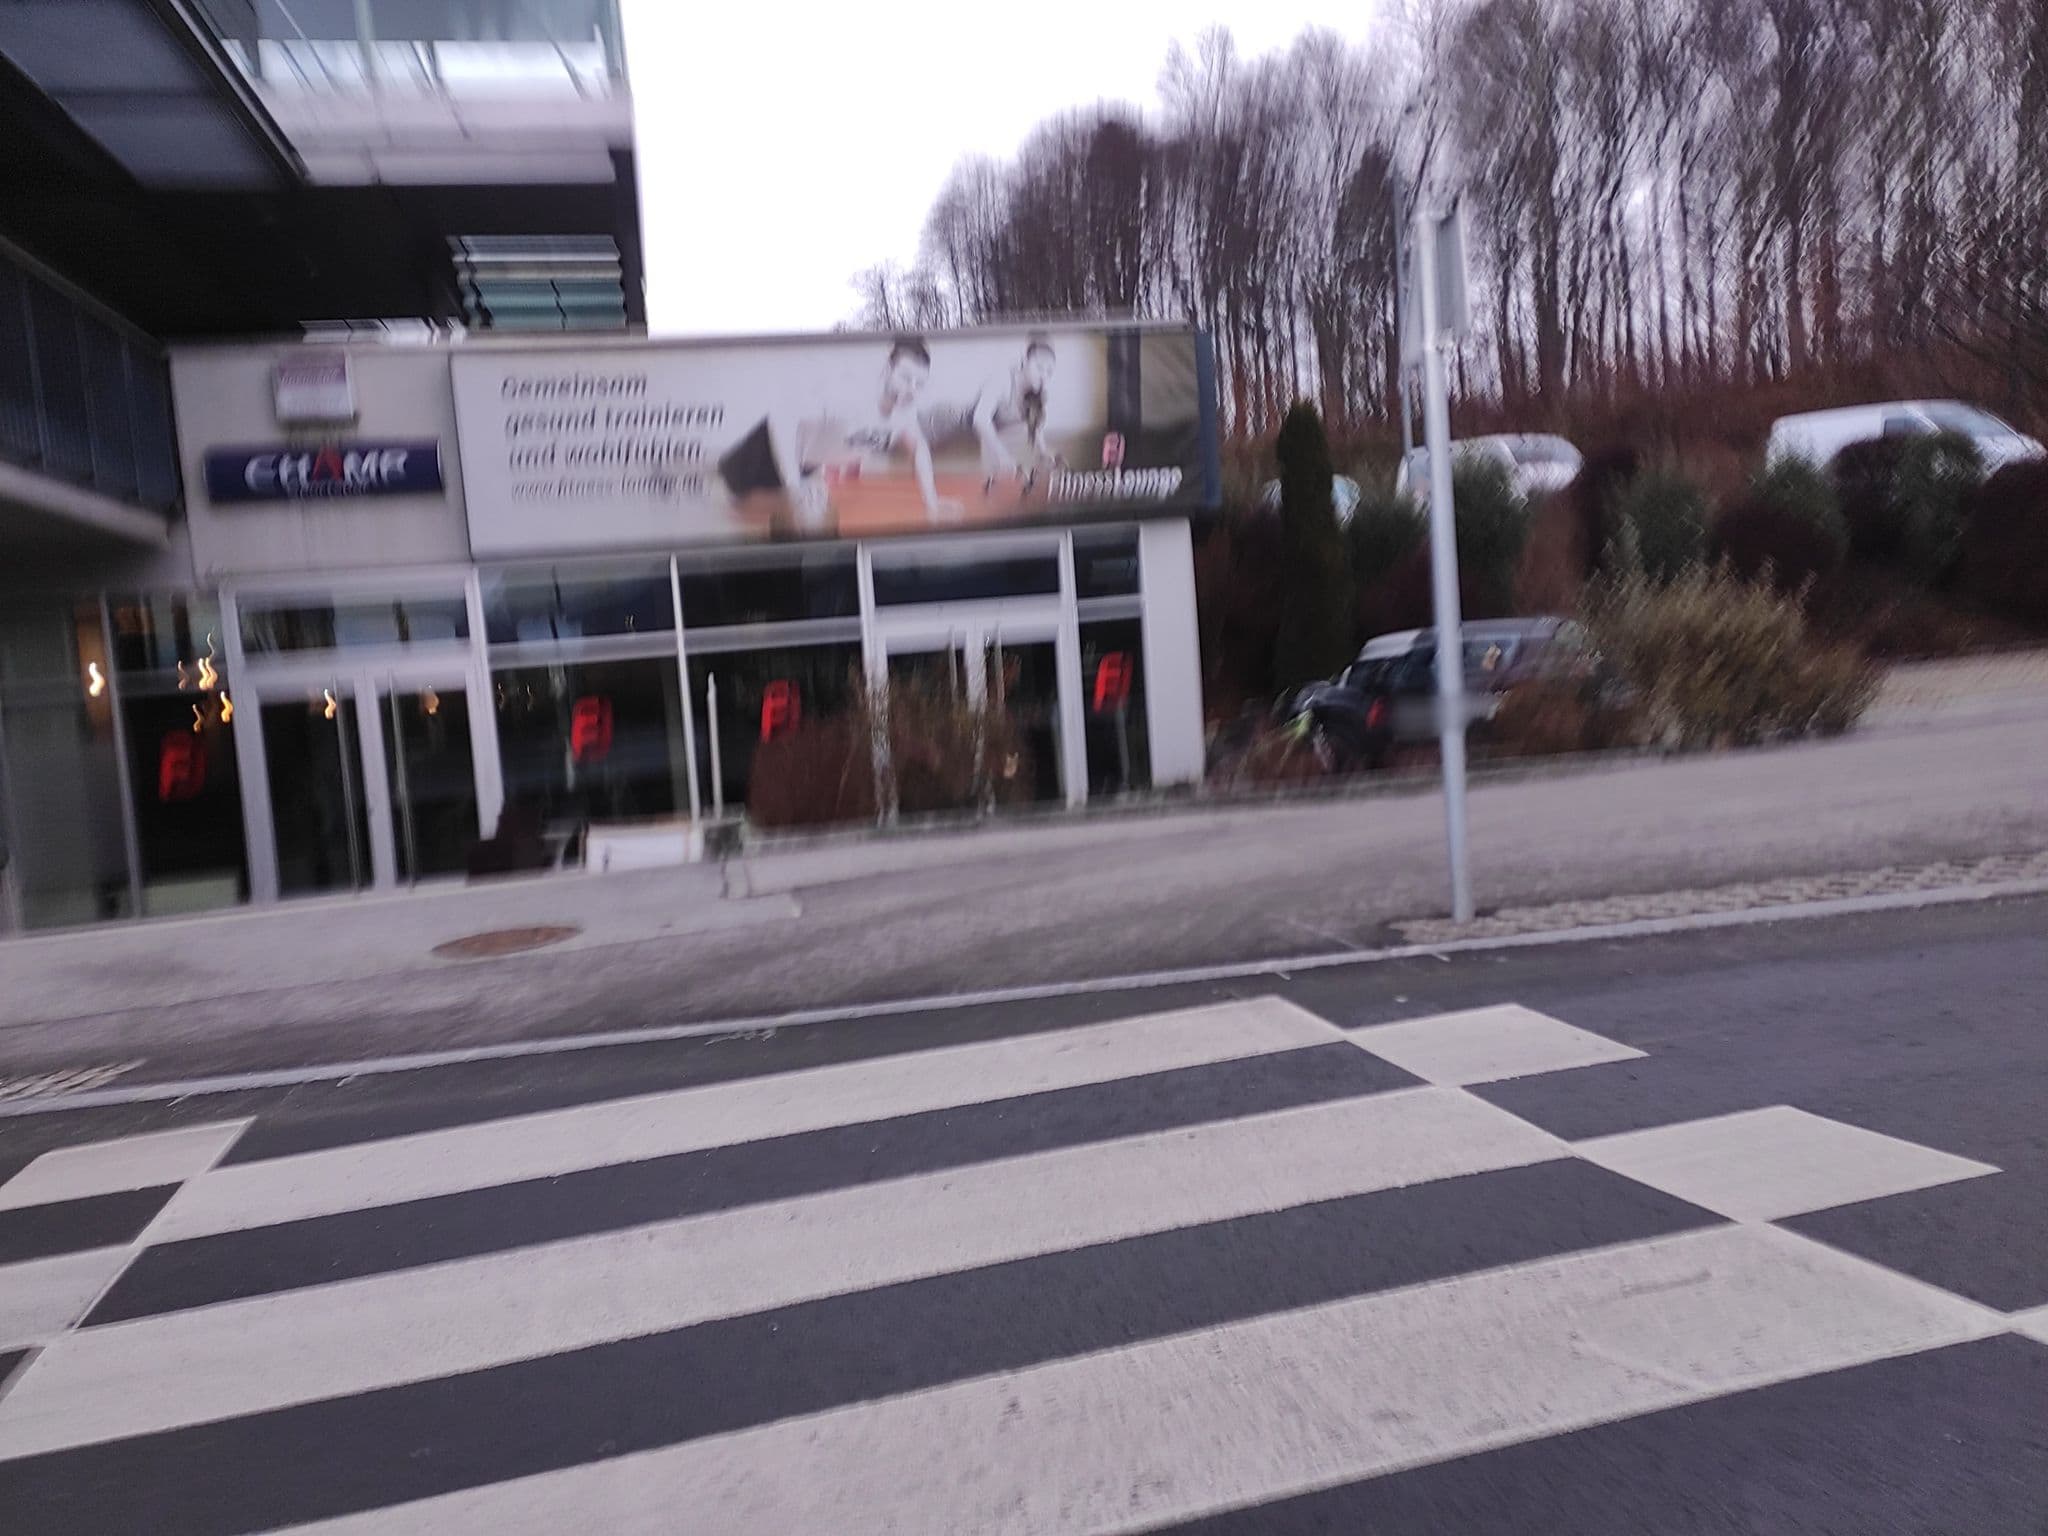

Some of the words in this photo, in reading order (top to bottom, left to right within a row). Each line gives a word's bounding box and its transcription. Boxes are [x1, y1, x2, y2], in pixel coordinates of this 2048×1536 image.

[501, 374, 647, 398] Gemeinsam
[505, 406, 597, 436] gesund
[605, 403, 723, 430] trainieren
[509, 443, 556, 468] und
